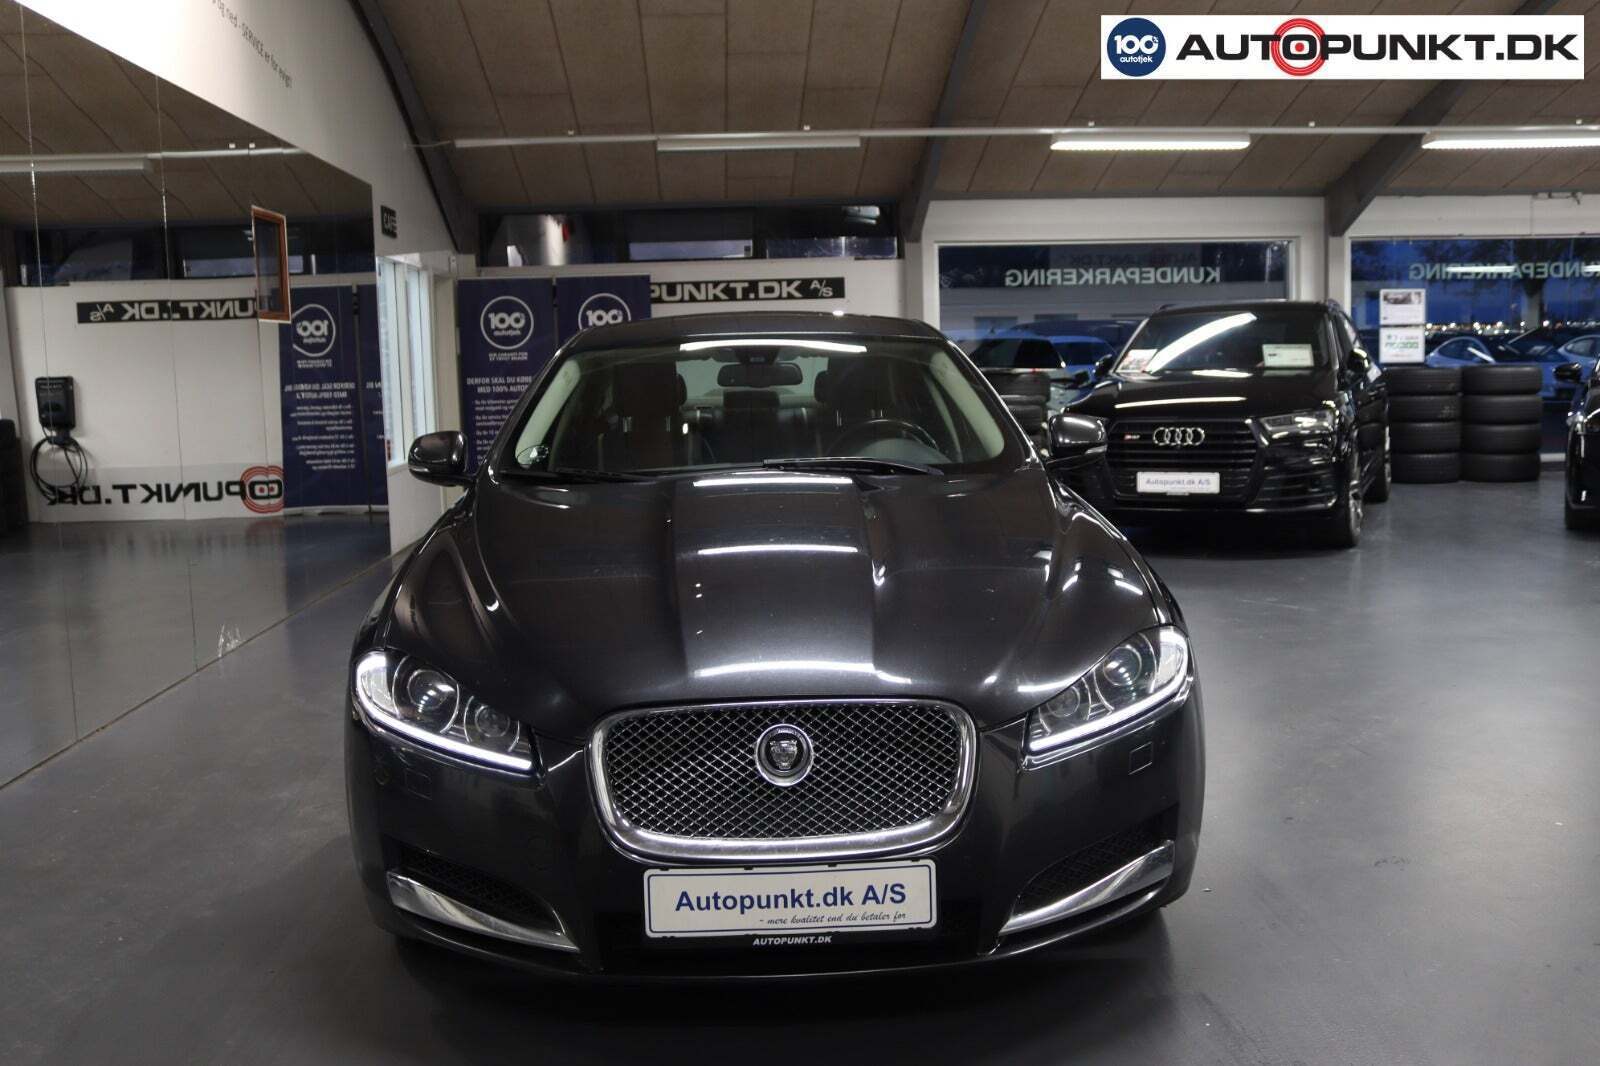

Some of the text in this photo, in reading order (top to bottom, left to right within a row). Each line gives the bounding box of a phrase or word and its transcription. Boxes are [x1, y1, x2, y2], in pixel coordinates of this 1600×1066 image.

[811, 279, 833, 297] A/S
[675, 883, 906, 915] Autopunkt.dk A/S
[752, 935, 832, 946] AUTOPUNKT.DK
